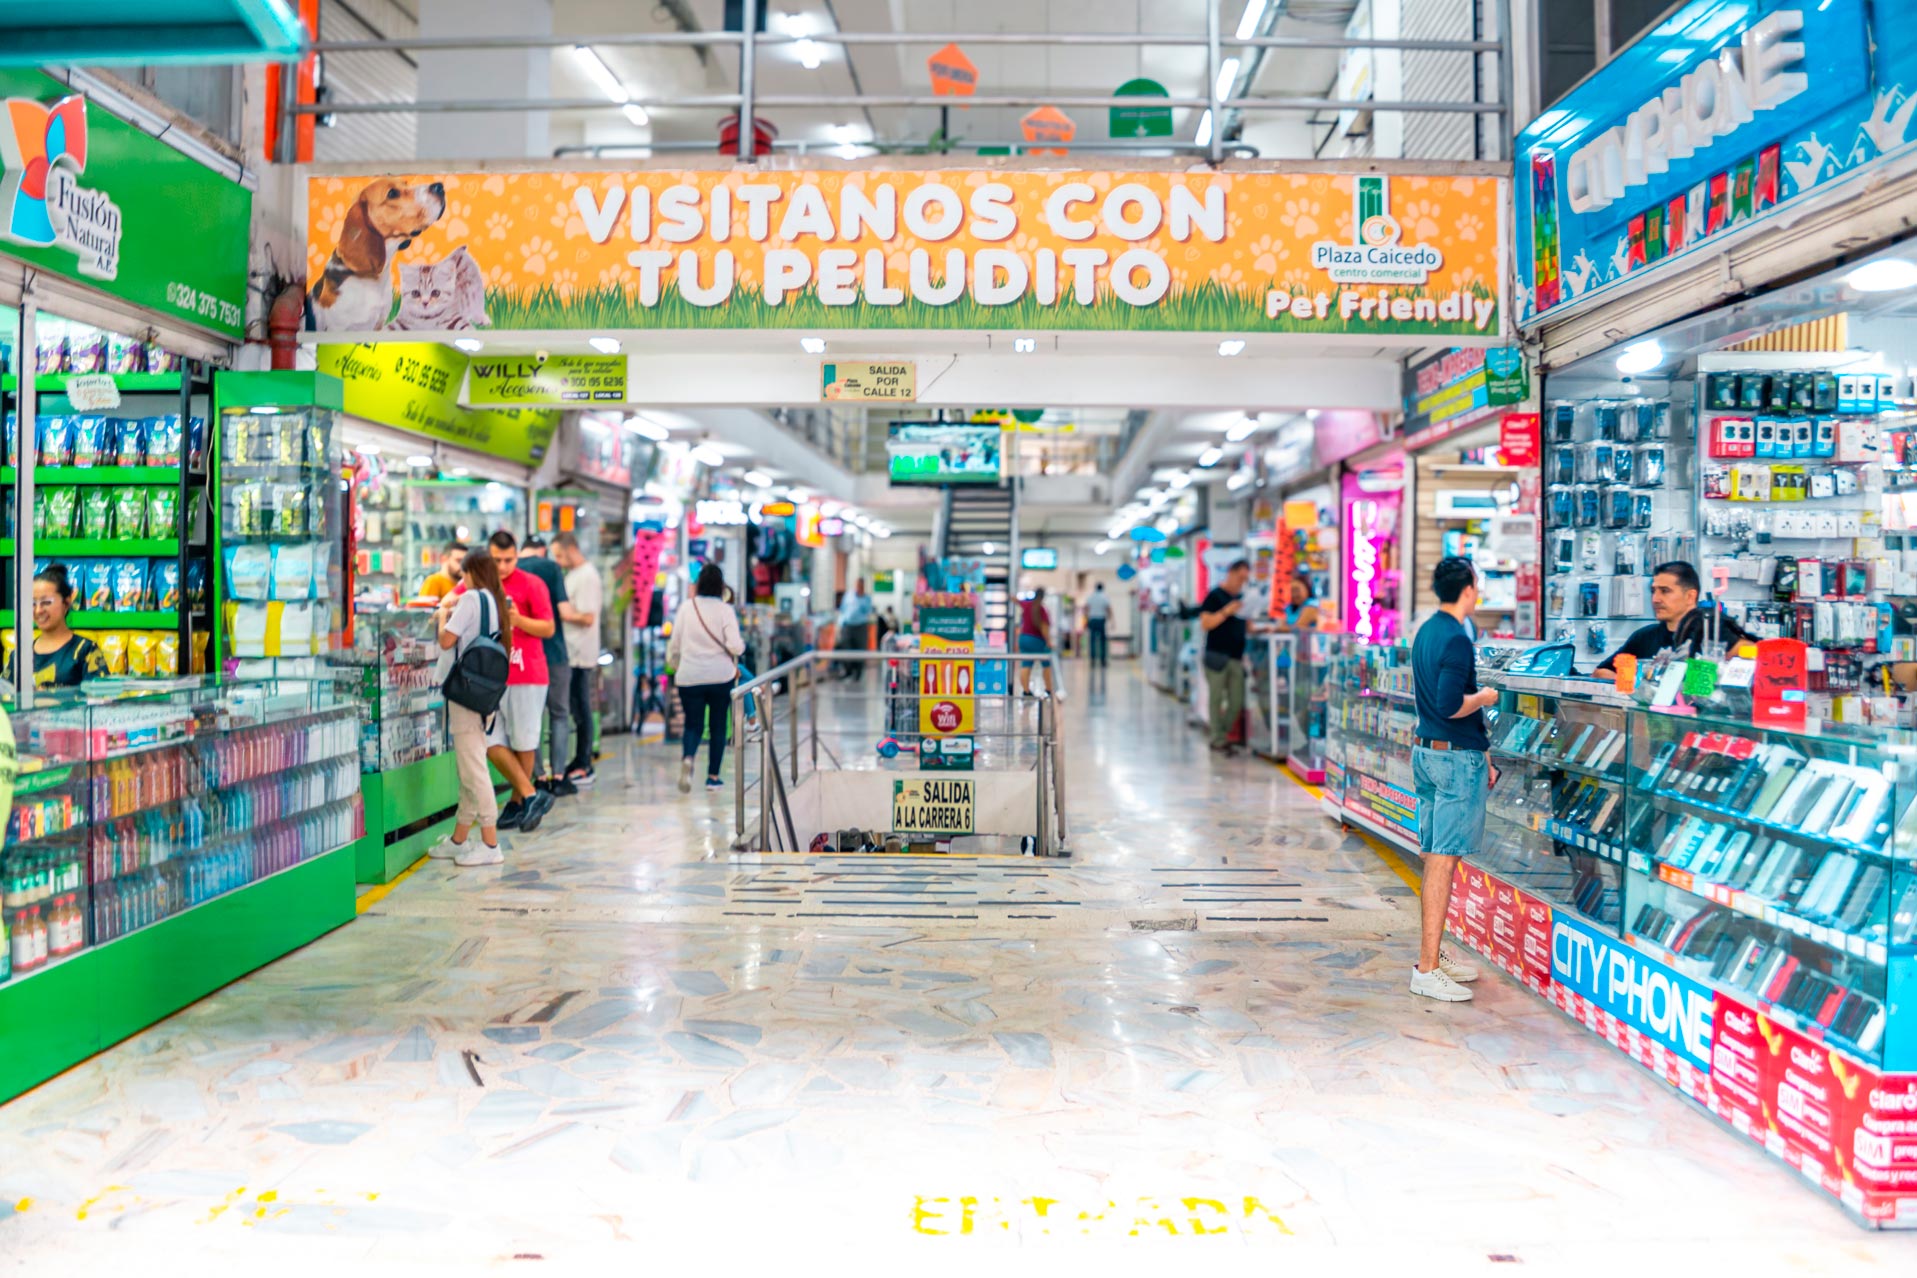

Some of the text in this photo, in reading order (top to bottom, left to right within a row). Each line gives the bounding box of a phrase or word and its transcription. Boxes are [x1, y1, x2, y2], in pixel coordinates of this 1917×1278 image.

[58, 176, 119, 232] Fusión
[573, 183, 1226, 244] VISITANOS CON
[67, 215, 117, 258] Natural
[1317, 246, 1437, 265] Plaza Caicedo
[627, 247, 1170, 308] TU PELUDITO
[1334, 268, 1421, 279] centro comercial
[175, 284, 242, 328] 324 375 7531
[1267, 288, 1496, 331] Pet Friendly
[473, 363, 543, 379] WILLY
[570, 377, 586, 387] 300
[603, 376, 624, 387] 6236
[869, 366, 907, 375] SALIDA
[876, 377, 899, 386] POR
[863, 388, 912, 397] CALLE 12
[923, 781, 971, 804] SALIDA
[896, 806, 971, 829] A LA CARRERA 6
[1724, 1010, 1753, 1036] Claro
[1790, 1046, 1824, 1075] Claro
[1780, 1088, 1800, 1112] SIM
[1868, 1083, 1917, 1111] Claro
[1862, 1112, 1905, 1136] Compra
[1855, 1134, 1884, 1159] SIM
